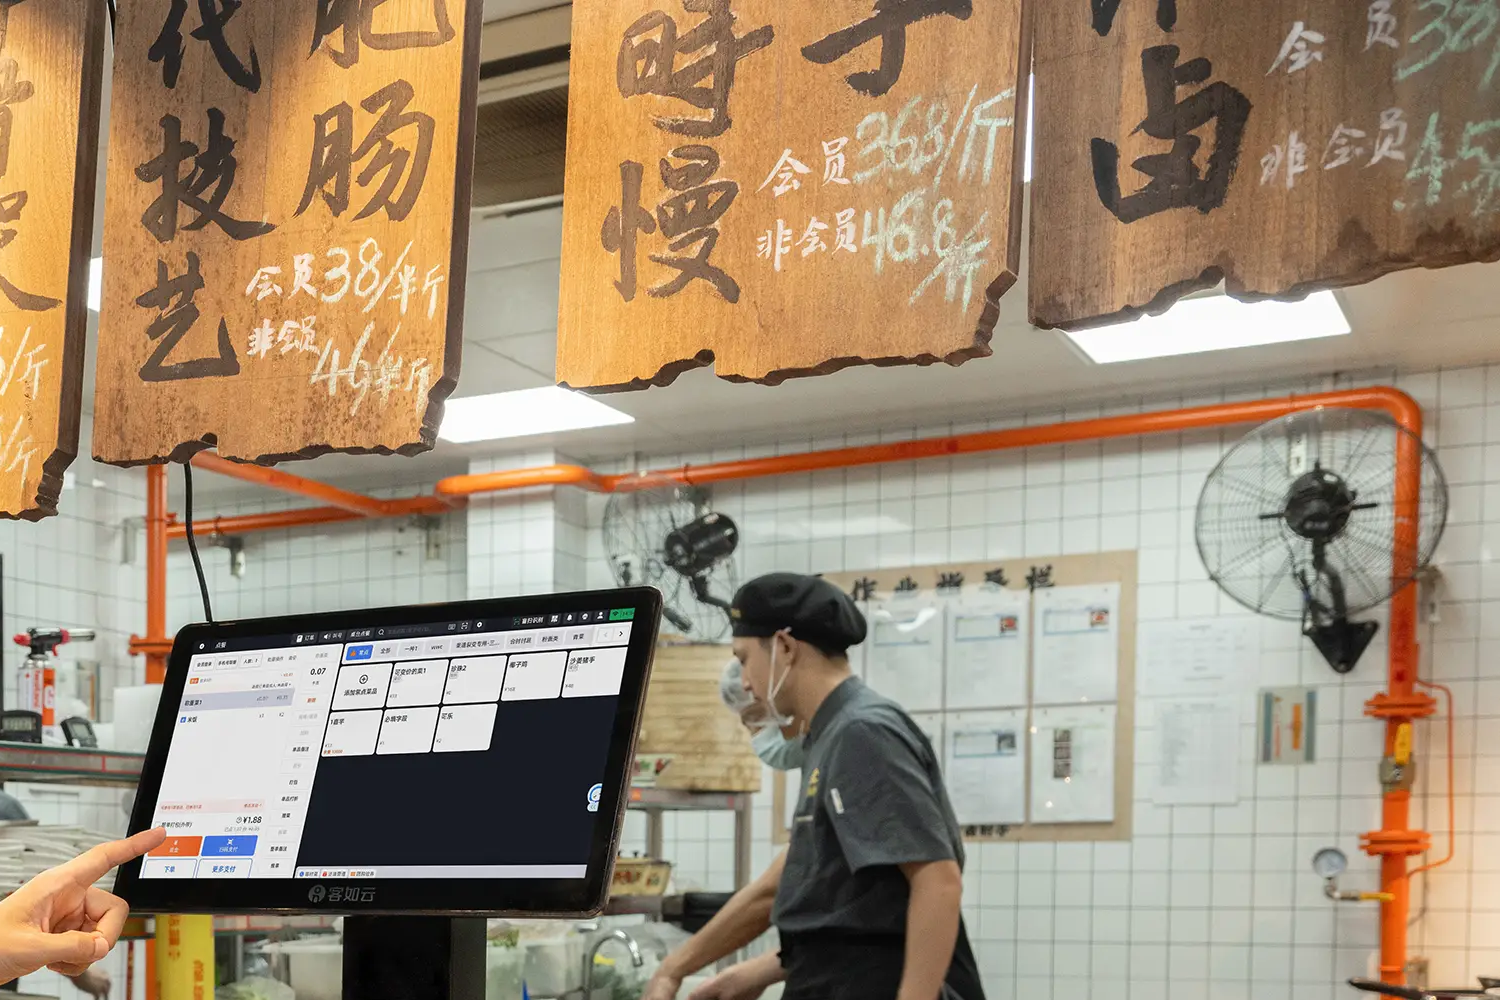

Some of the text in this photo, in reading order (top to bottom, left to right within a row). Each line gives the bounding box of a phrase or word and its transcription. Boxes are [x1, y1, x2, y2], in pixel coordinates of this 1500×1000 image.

[310, 668, 326, 676] 0.07
[243, 816, 263, 824] ¥1.88
[212, 865, 236, 874] 更多支付
[328, 887, 376, 902] 客如云
